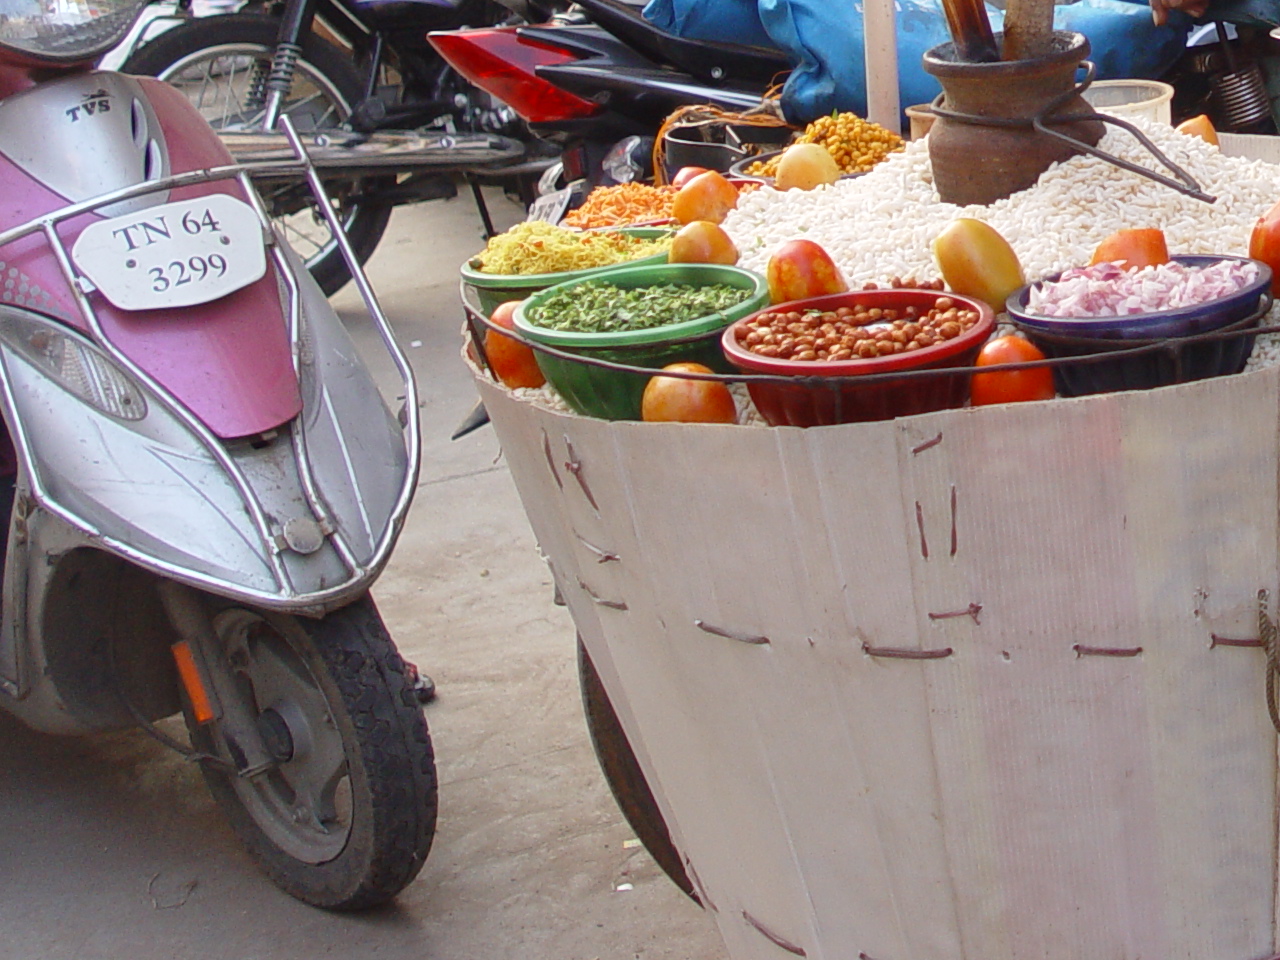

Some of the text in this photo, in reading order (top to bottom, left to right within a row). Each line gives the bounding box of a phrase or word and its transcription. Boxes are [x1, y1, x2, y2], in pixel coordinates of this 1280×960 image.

[66, 99, 111, 122] TVS
[113, 208, 222, 252] TN 64
[148, 253, 227, 292] 3299
